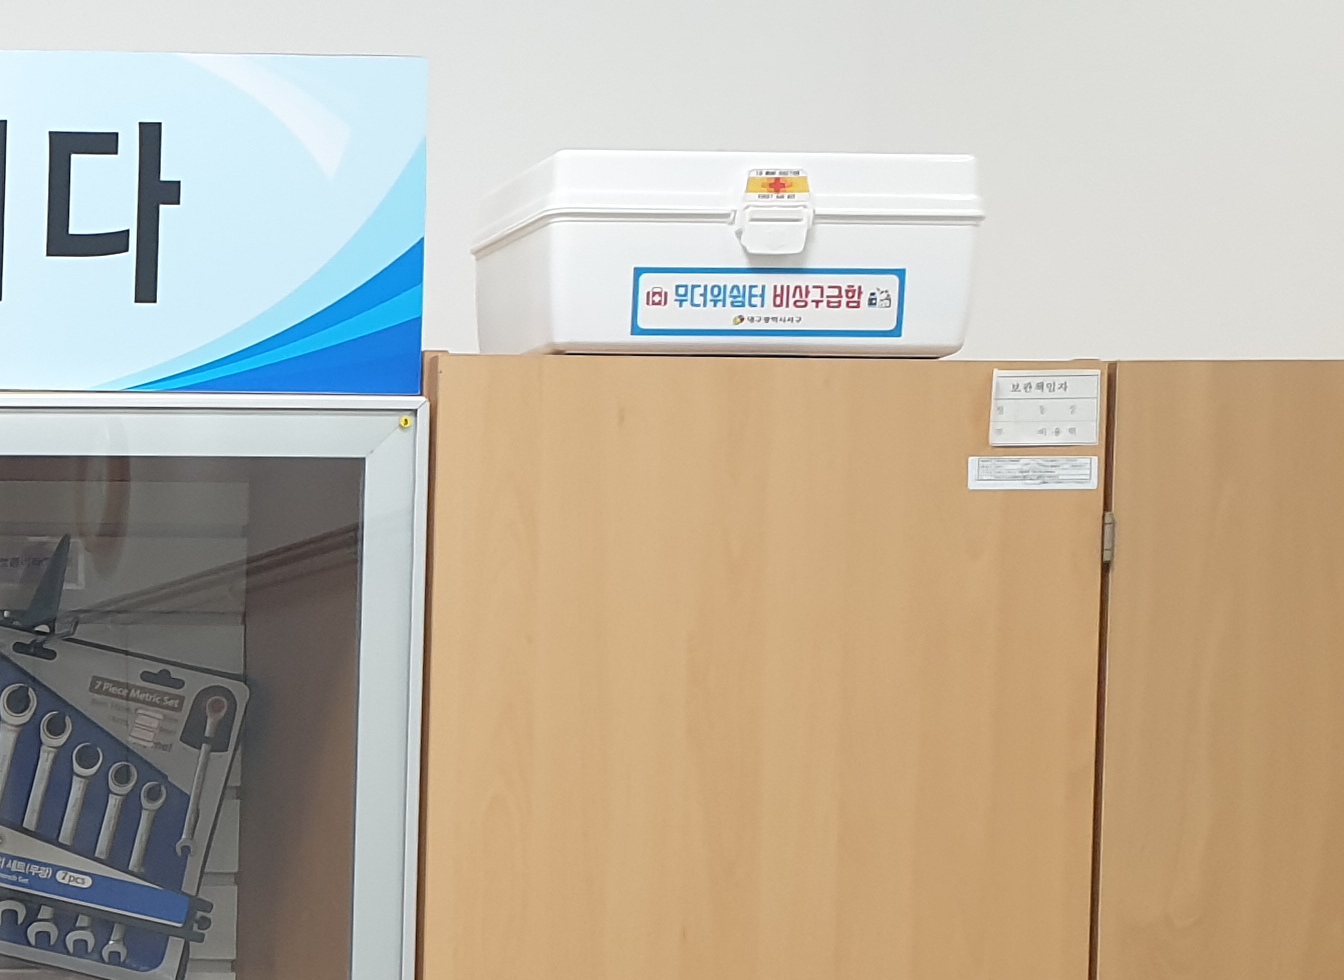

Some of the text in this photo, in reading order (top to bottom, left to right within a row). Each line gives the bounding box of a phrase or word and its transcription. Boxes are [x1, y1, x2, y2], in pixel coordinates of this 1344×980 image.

[674, 284, 863, 309] 무더위쉼터 비상구급함
[102, 682, 128, 697] Piece
[129, 688, 160, 704] Metric
[163, 696, 180, 708] Set
[61, 871, 86, 886] 7pcs
